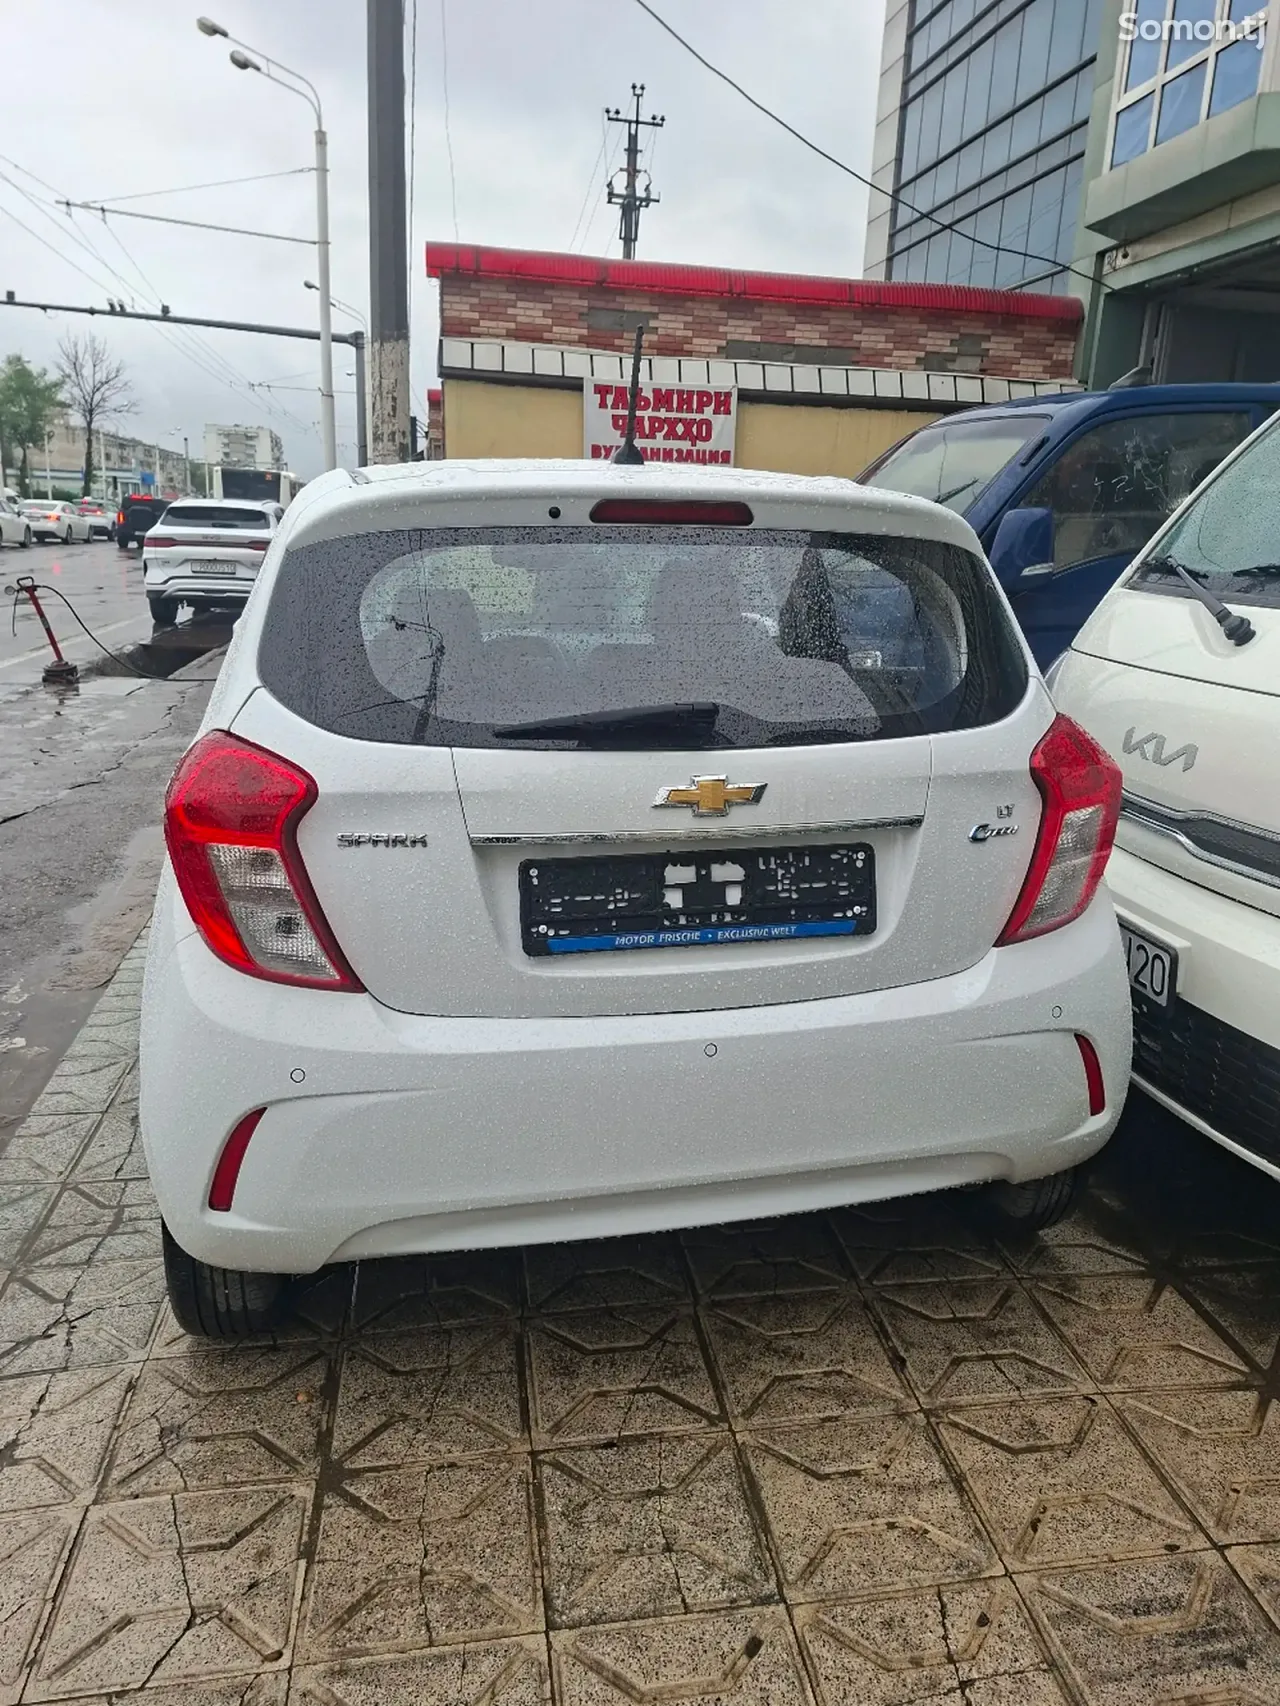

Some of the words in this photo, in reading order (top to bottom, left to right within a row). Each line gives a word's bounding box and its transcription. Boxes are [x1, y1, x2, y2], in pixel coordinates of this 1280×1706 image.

[591, 444, 731, 465] ВУАНИЗАЦИЯ
[1122, 726, 1199, 772] KIA
[336, 832, 428, 849] SPARK
[615, 935, 654, 946] MOTOR
[659, 932, 701, 943] FRISCHE
[717, 927, 769, 939] EXCLUSIVE
[771, 926, 797, 936] WELT
